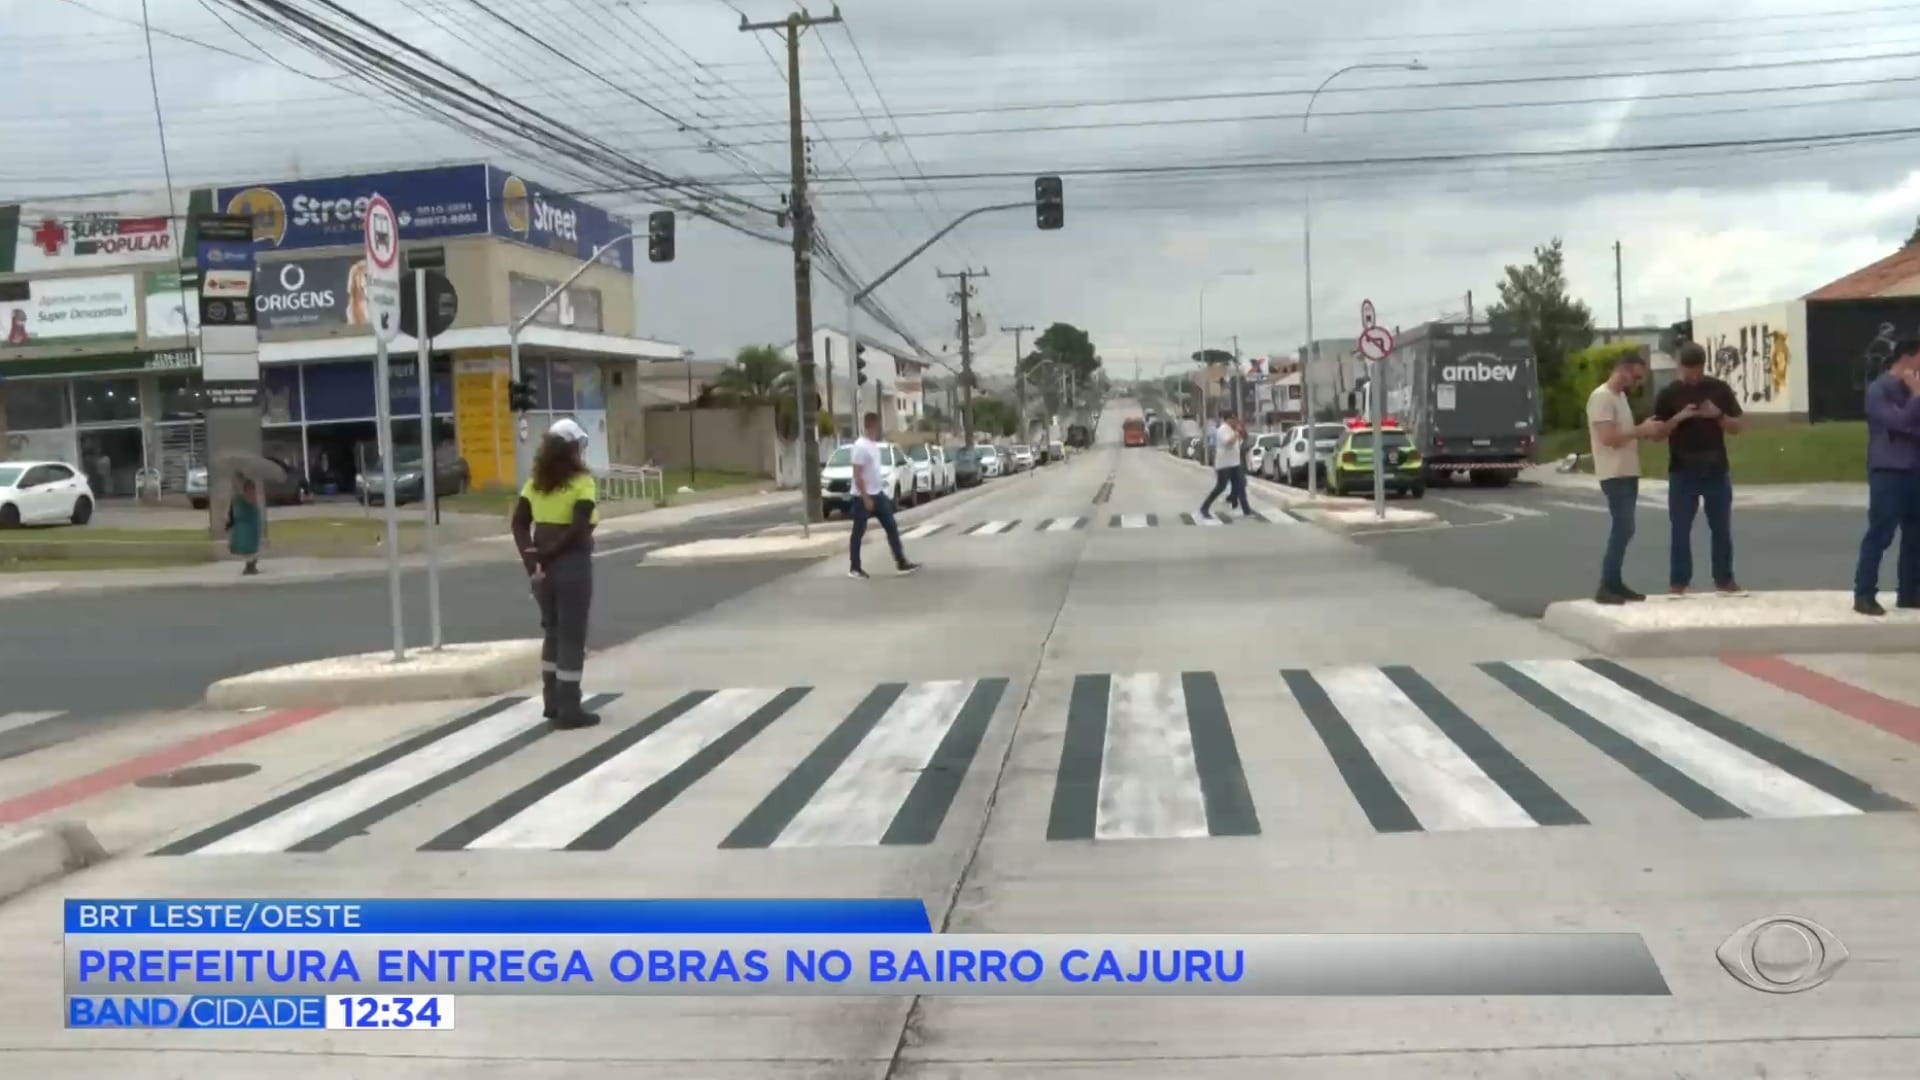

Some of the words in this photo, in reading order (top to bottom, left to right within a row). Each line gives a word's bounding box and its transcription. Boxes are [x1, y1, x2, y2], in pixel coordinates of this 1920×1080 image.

[292, 195, 372, 227] Stree
[533, 200, 578, 242] Street
[72, 219, 121, 240] SUPER
[96, 234, 170, 254] POPULAR
[255, 290, 335, 312] ORIGENS
[1442, 362, 1517, 381] ambev
